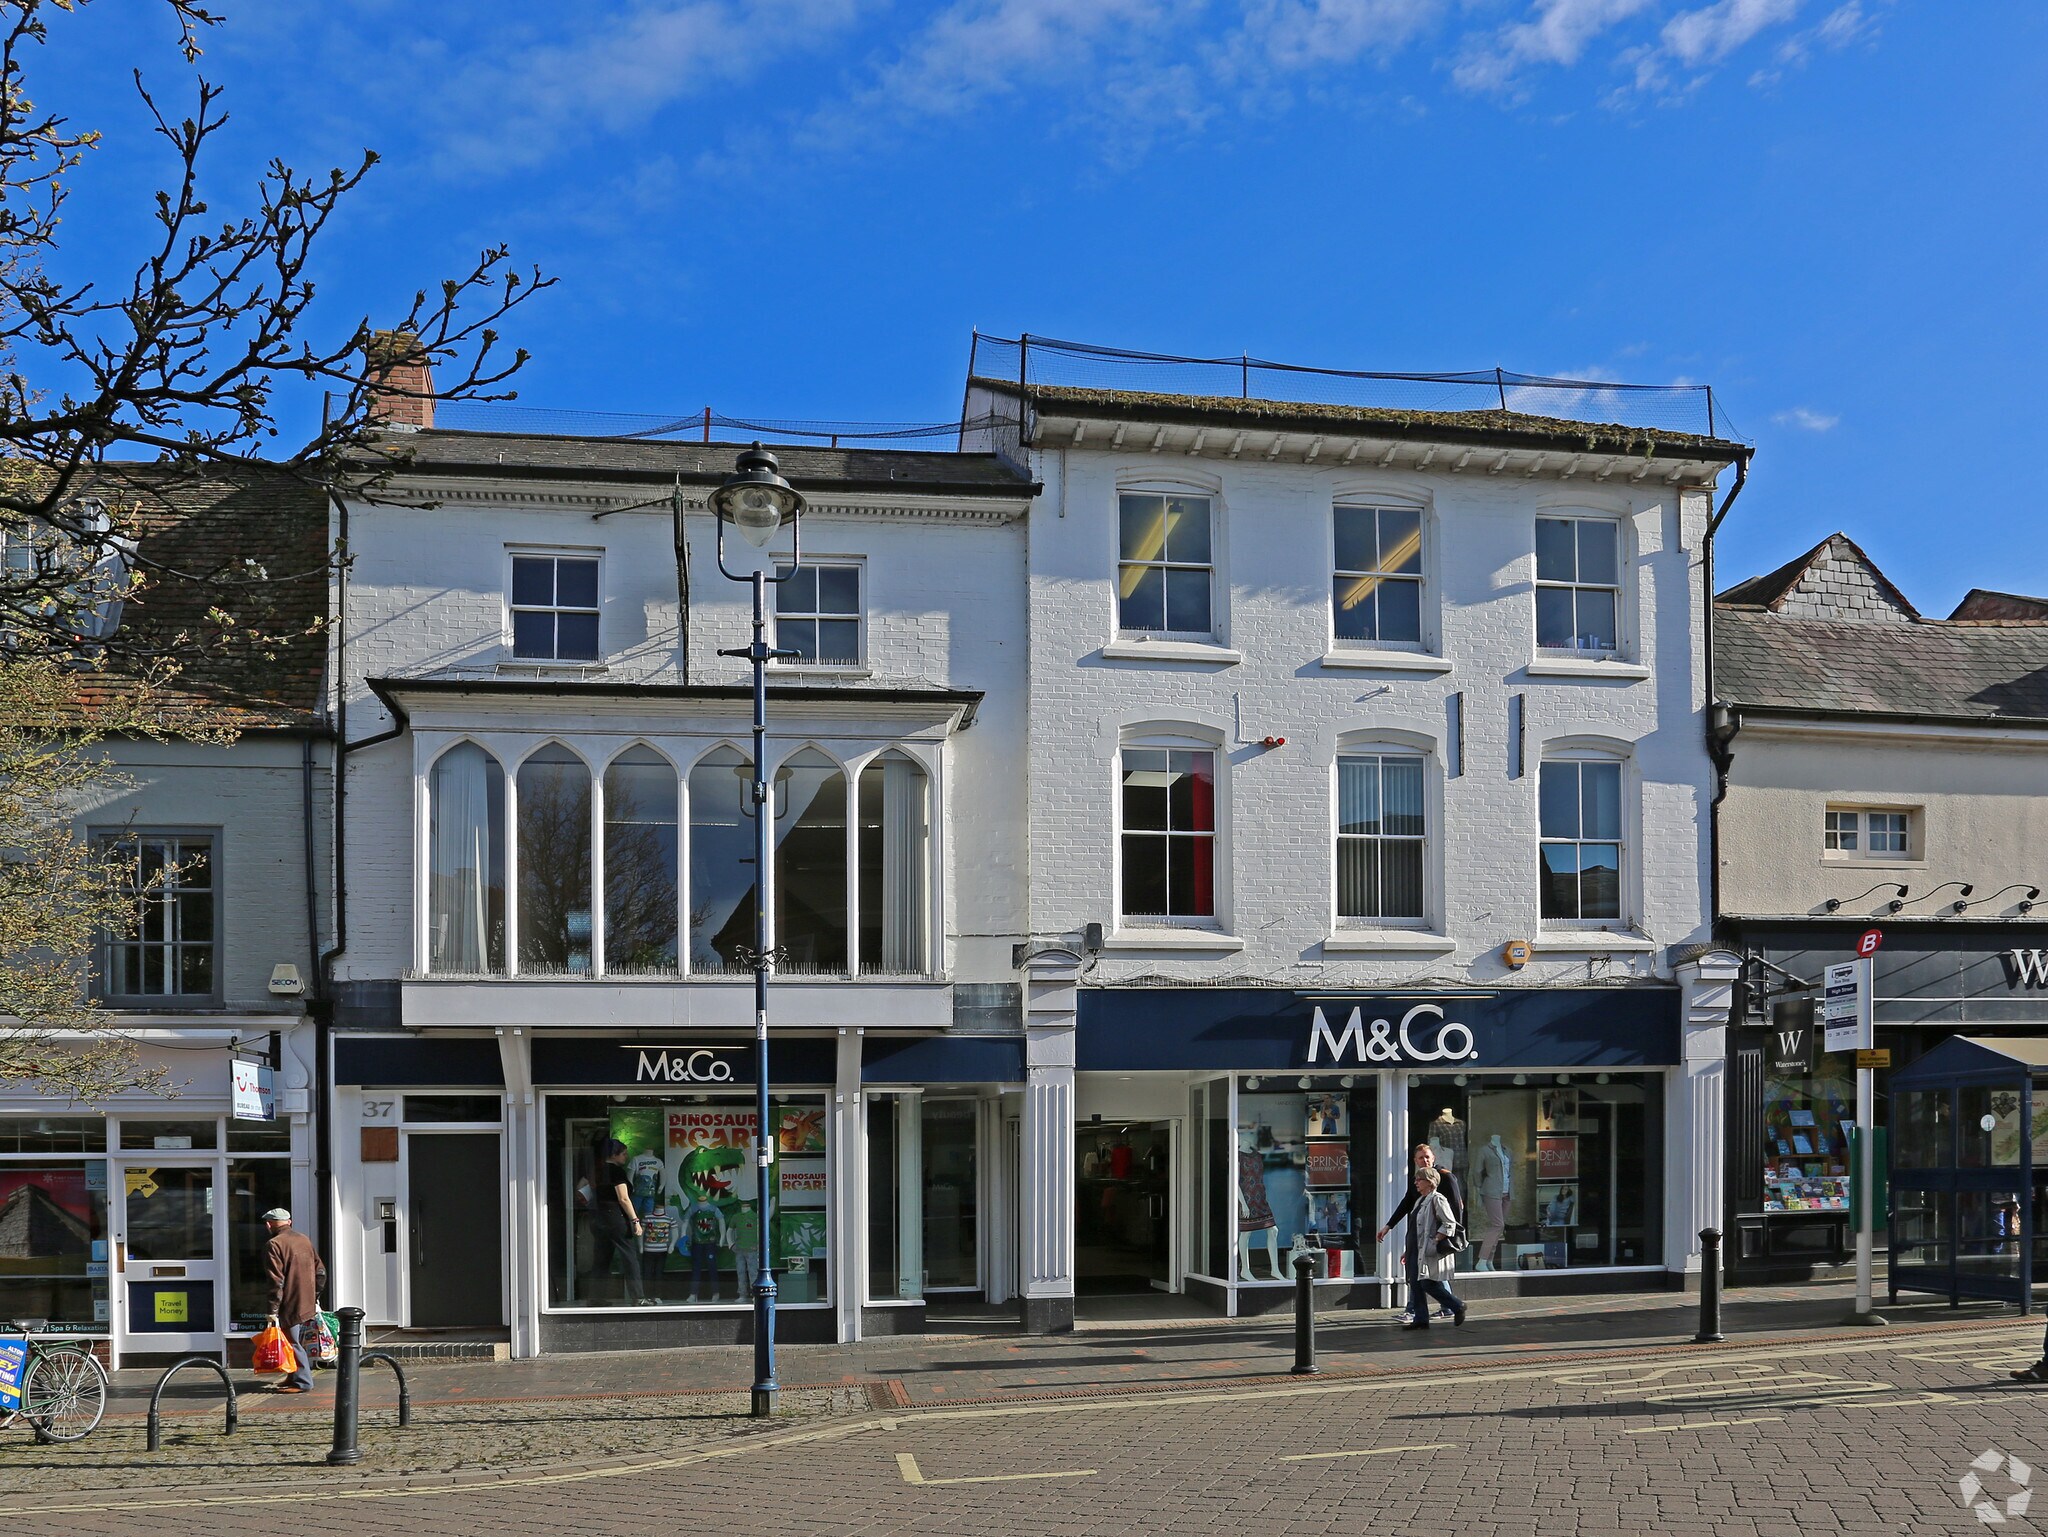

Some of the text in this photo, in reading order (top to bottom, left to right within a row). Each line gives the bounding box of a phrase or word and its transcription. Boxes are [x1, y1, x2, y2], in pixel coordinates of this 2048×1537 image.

[1861, 933, 1877, 953] B
[2010, 948, 2048, 984] W
[1307, 1003, 1479, 1062] M&Co.
[1778, 1030, 1804, 1056] W
[636, 1050, 734, 1082] M&Co.
[1775, 1059, 1807, 1068] Waterstone's
[249, 1082, 272, 1095] Thomson
[362, 1101, 394, 1118] 37
[669, 1113, 758, 1127] DINOSAUR
[1306, 1155, 1349, 1168] SPRING
[1540, 1149, 1575, 1161] DENIM
[161, 1299, 182, 1307] Travel
[160, 1307, 184, 1315] Money
